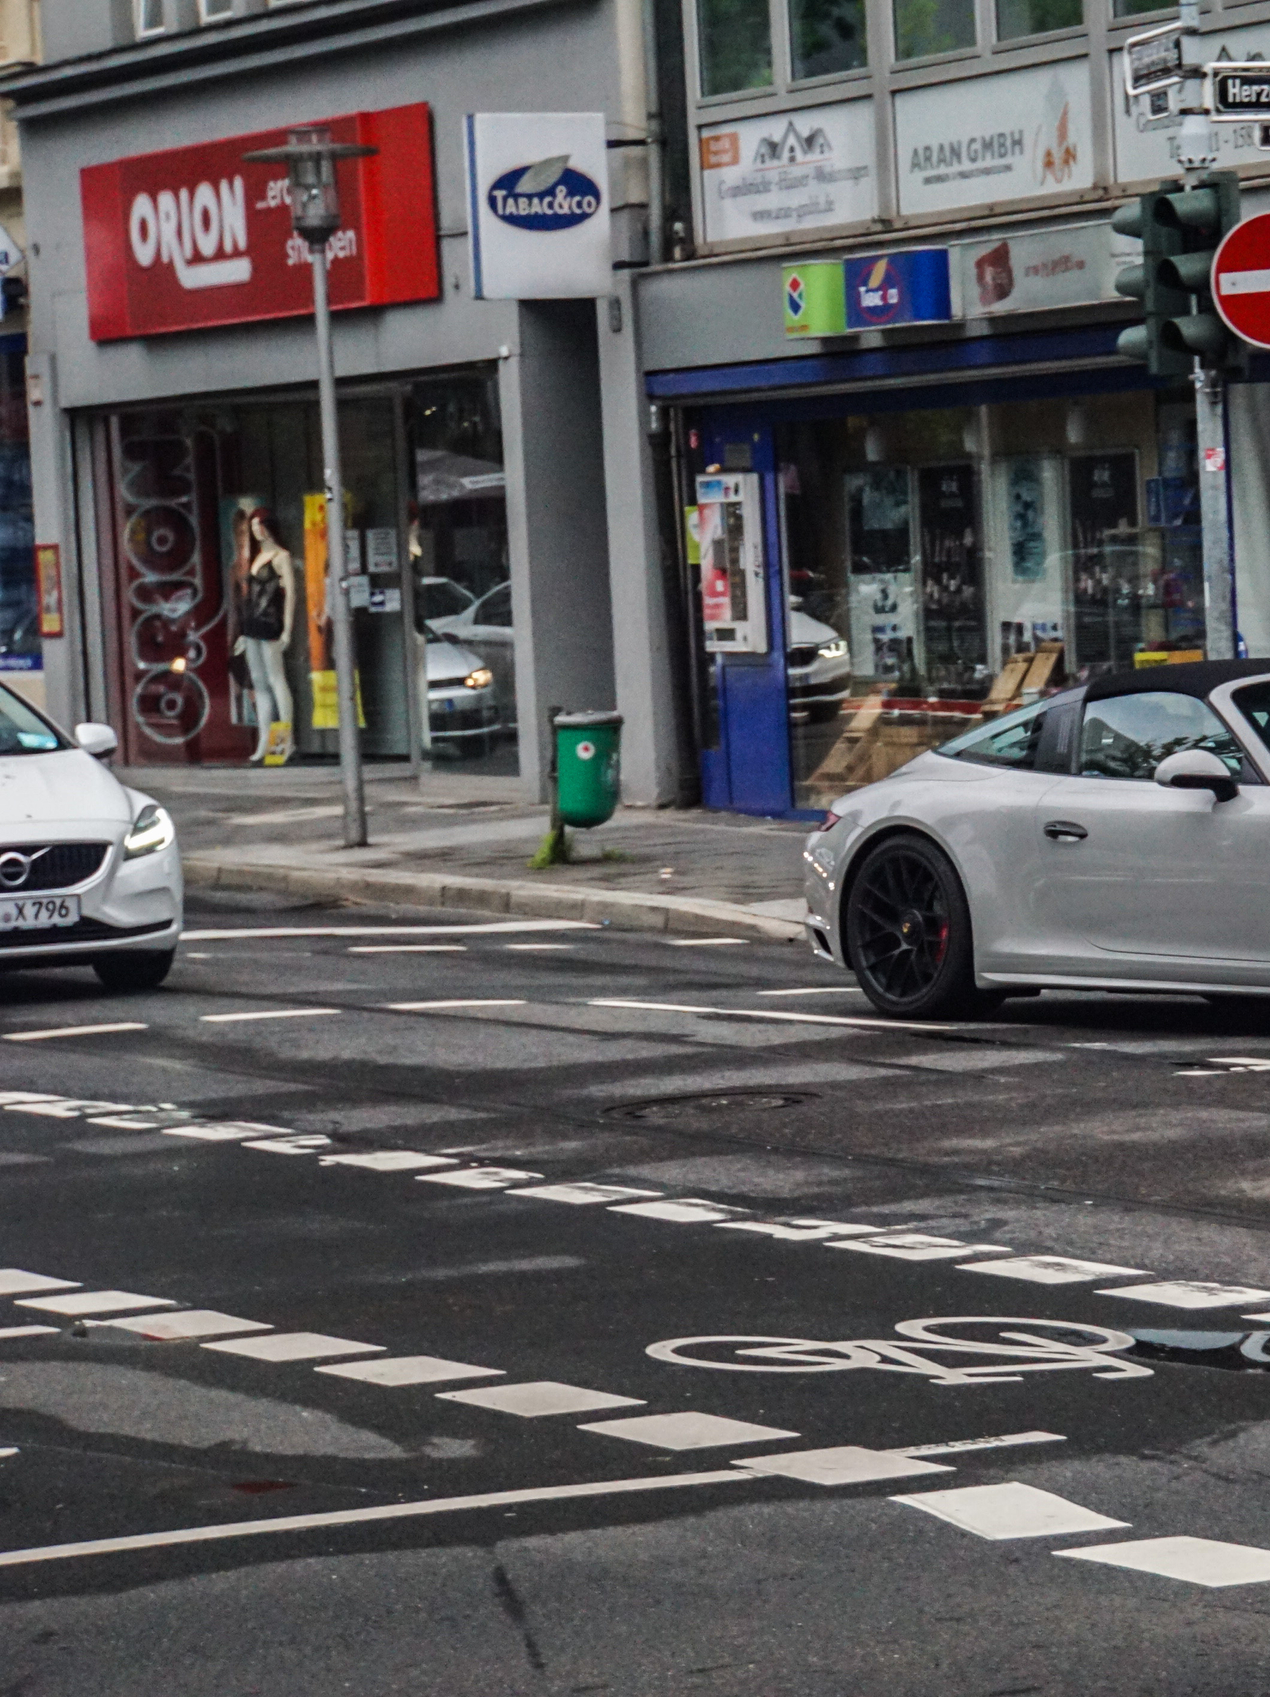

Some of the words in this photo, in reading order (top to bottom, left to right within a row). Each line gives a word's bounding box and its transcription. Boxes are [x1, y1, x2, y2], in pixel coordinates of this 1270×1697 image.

[910, 139, 963, 174] ARAN
[967, 129, 1025, 164] GMBH
[130, 174, 252, 290] ORION
[32, 899, 69, 920] 796
